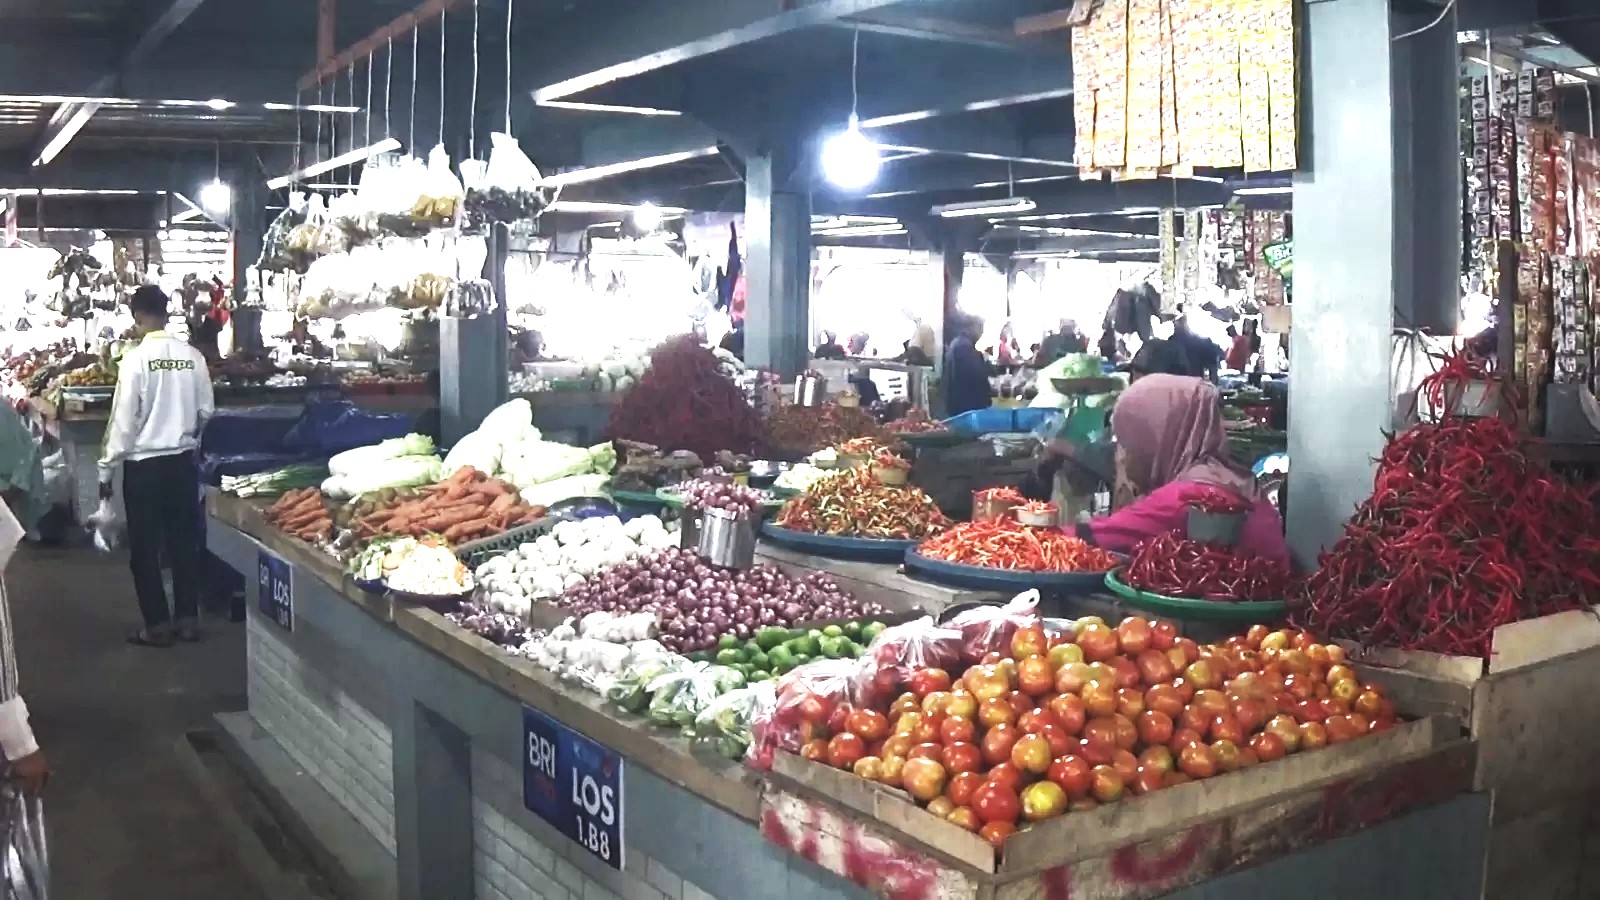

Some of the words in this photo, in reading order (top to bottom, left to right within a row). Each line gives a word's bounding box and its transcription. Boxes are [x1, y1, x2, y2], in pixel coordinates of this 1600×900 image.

[148, 359, 195, 371] Kappa
[273, 577, 289, 606] LOS
[529, 731, 556, 778] BRI
[572, 767, 614, 825] LOS
[576, 815, 610, 860] 1.B8
